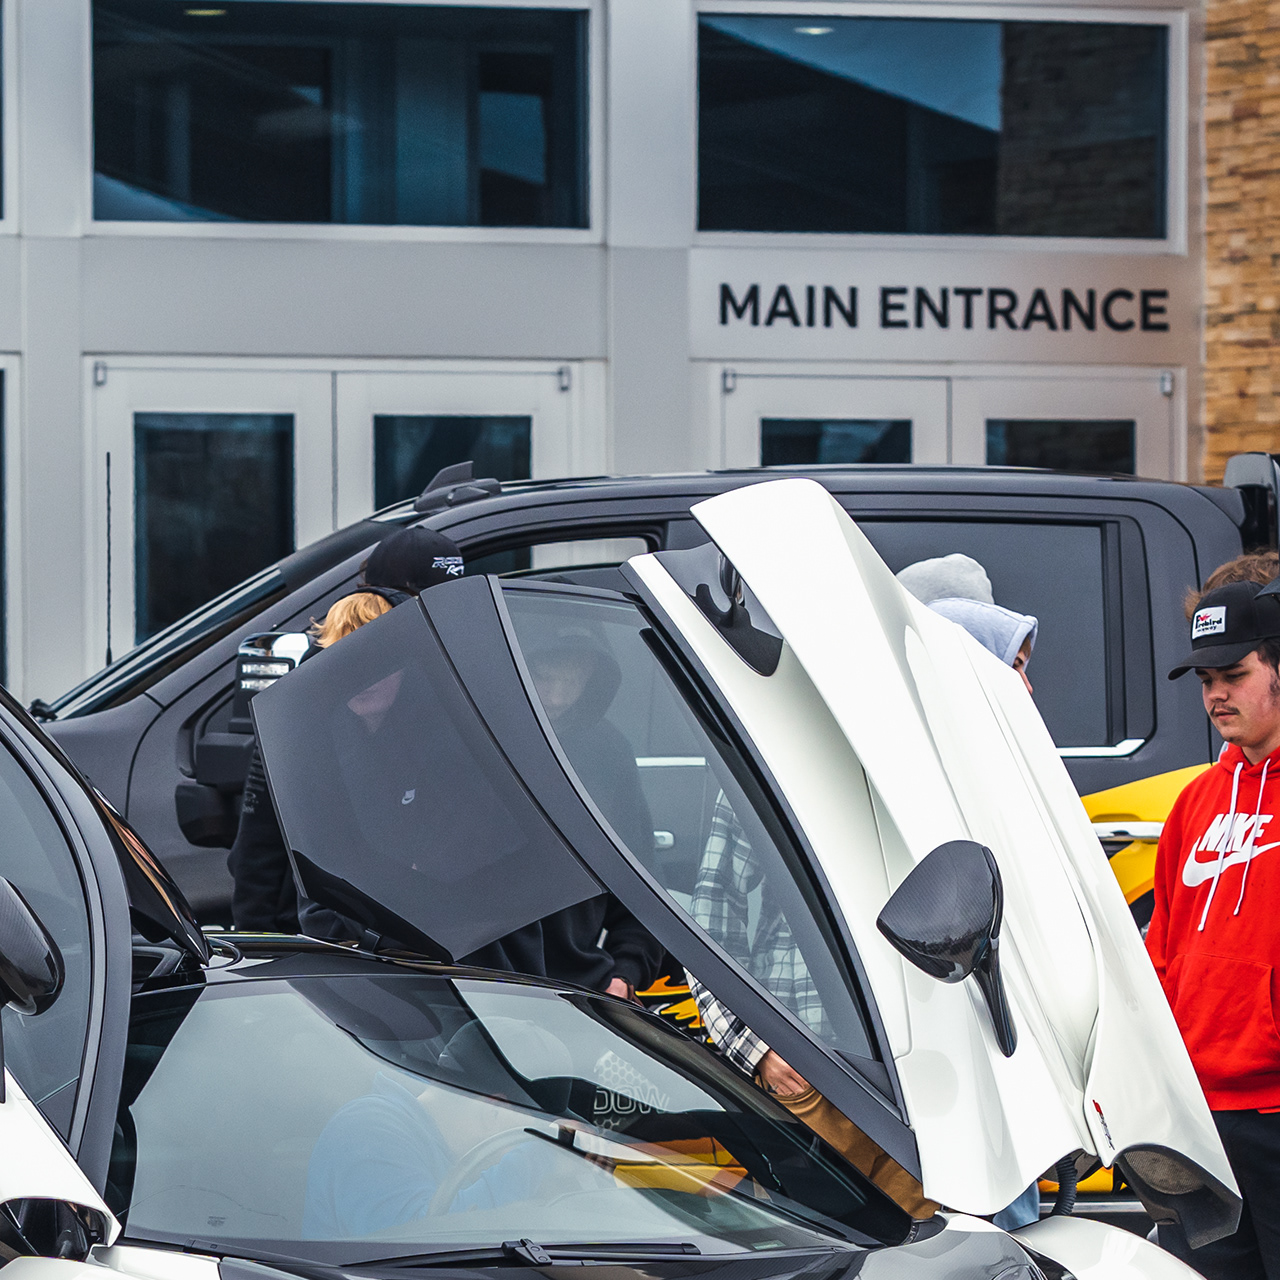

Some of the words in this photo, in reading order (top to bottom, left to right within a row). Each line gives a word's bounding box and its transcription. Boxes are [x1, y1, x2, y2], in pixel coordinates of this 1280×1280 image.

[719, 283, 859, 329] MAIN
[878, 285, 1170, 332] ENTRANCE
[1196, 812, 1274, 853] NIKE
